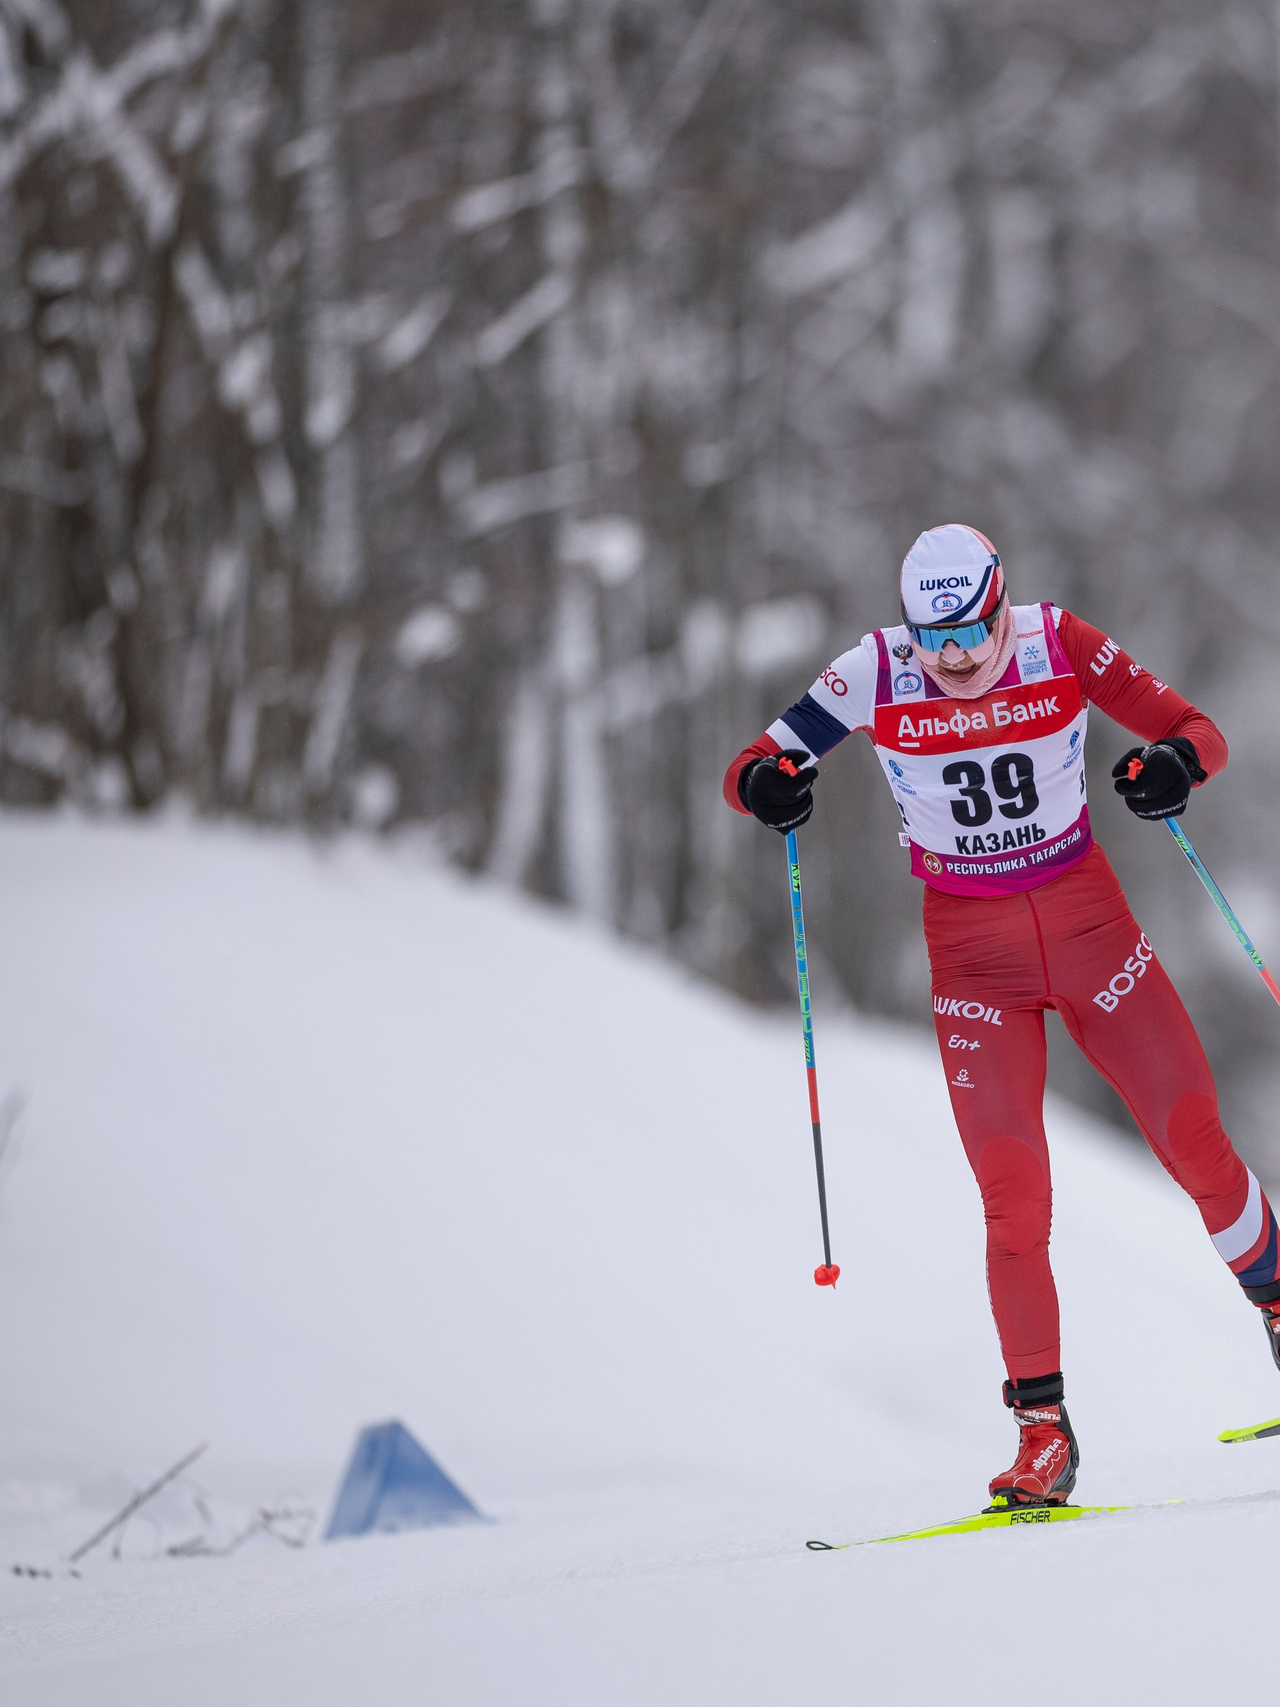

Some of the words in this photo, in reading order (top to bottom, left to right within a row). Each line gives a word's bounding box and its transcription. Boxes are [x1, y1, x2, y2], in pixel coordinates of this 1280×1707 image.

[919, 576, 972, 591] LUKOIL
[897, 708, 988, 745] Альфа
[991, 695, 1061, 727] Банк
[942, 752, 1040, 828] 39
[946, 857, 1028, 875] РЕСПУБЛИКА
[1028, 827, 1082, 866] ТАТАРСТАН
[955, 822, 1047, 856] КАЗАНЬ
[1092, 931, 1153, 1014] BOSCO
[933, 995, 1003, 1026] LUKOIL
[948, 1034, 981, 1051] En+
[1024, 1410, 1062, 1420] alpina
[1032, 1438, 1063, 1471] alpina
[1010, 1510, 1051, 1526] FISCHER
